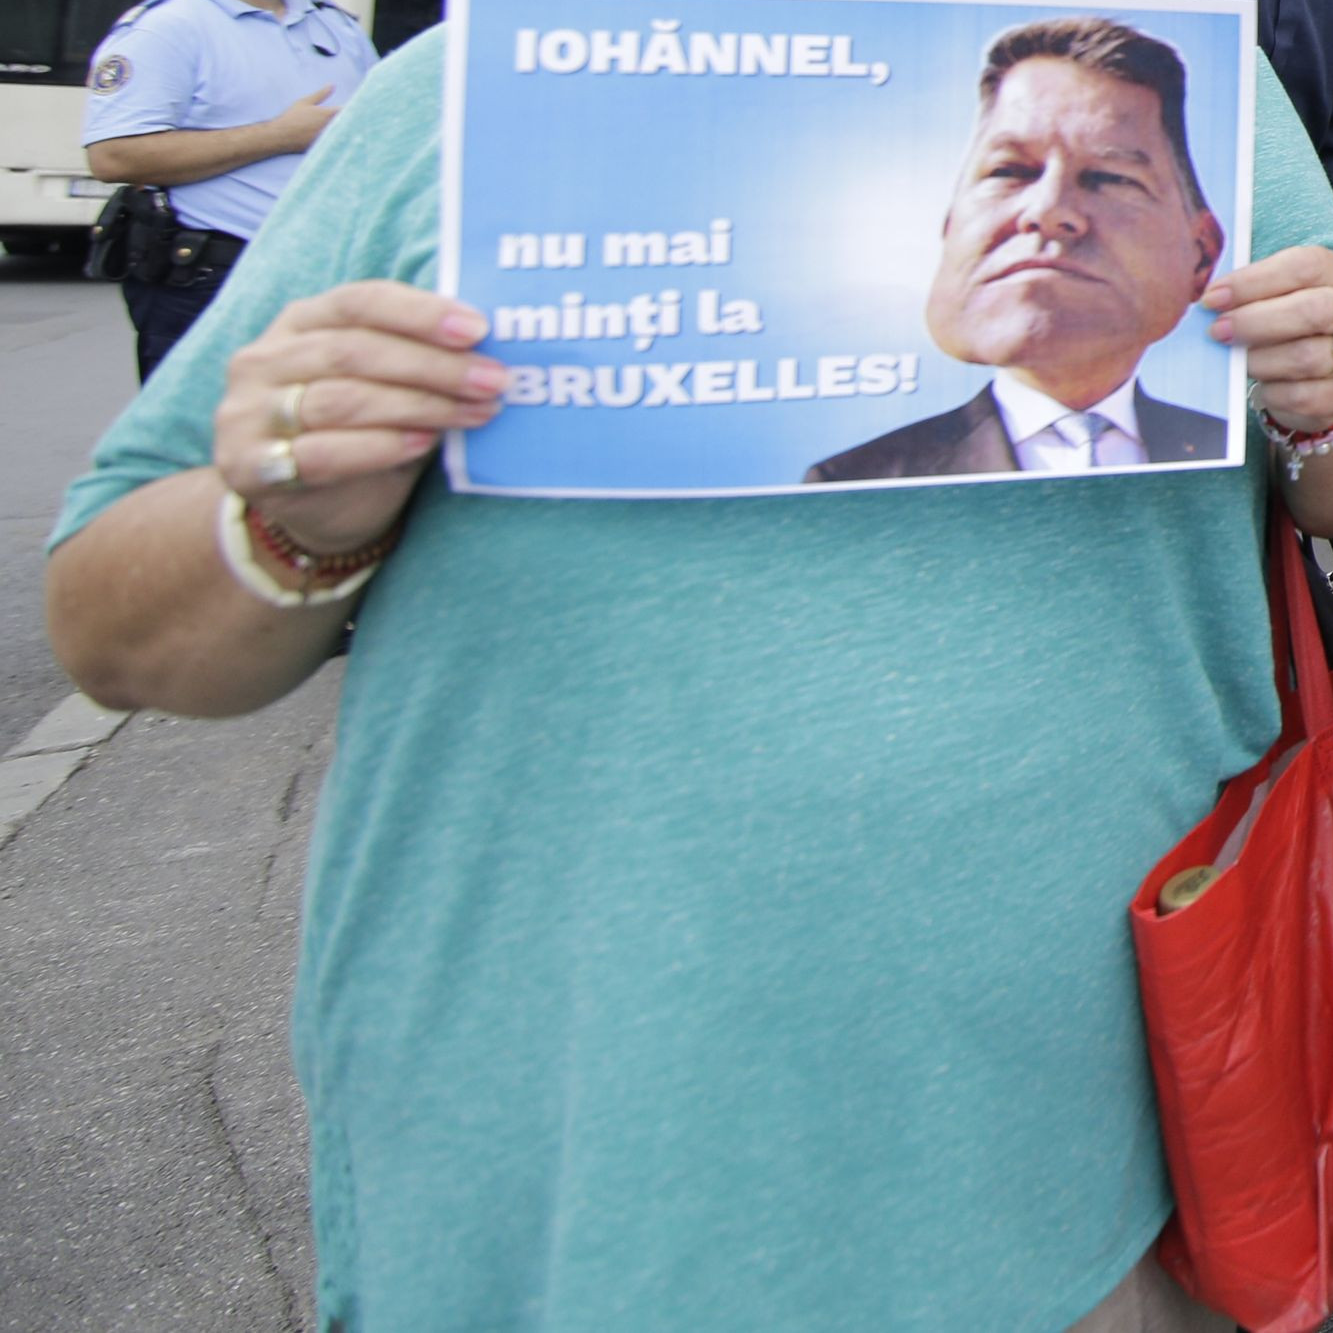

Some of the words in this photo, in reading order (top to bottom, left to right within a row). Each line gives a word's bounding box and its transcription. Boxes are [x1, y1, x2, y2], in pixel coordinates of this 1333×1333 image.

[514, 20, 891, 86] IOHĂNNEL,
[498, 228, 585, 269] nu
[602, 218, 733, 267] mai
[697, 290, 764, 335] la
[504, 353, 920, 407] BRUXELLES!
